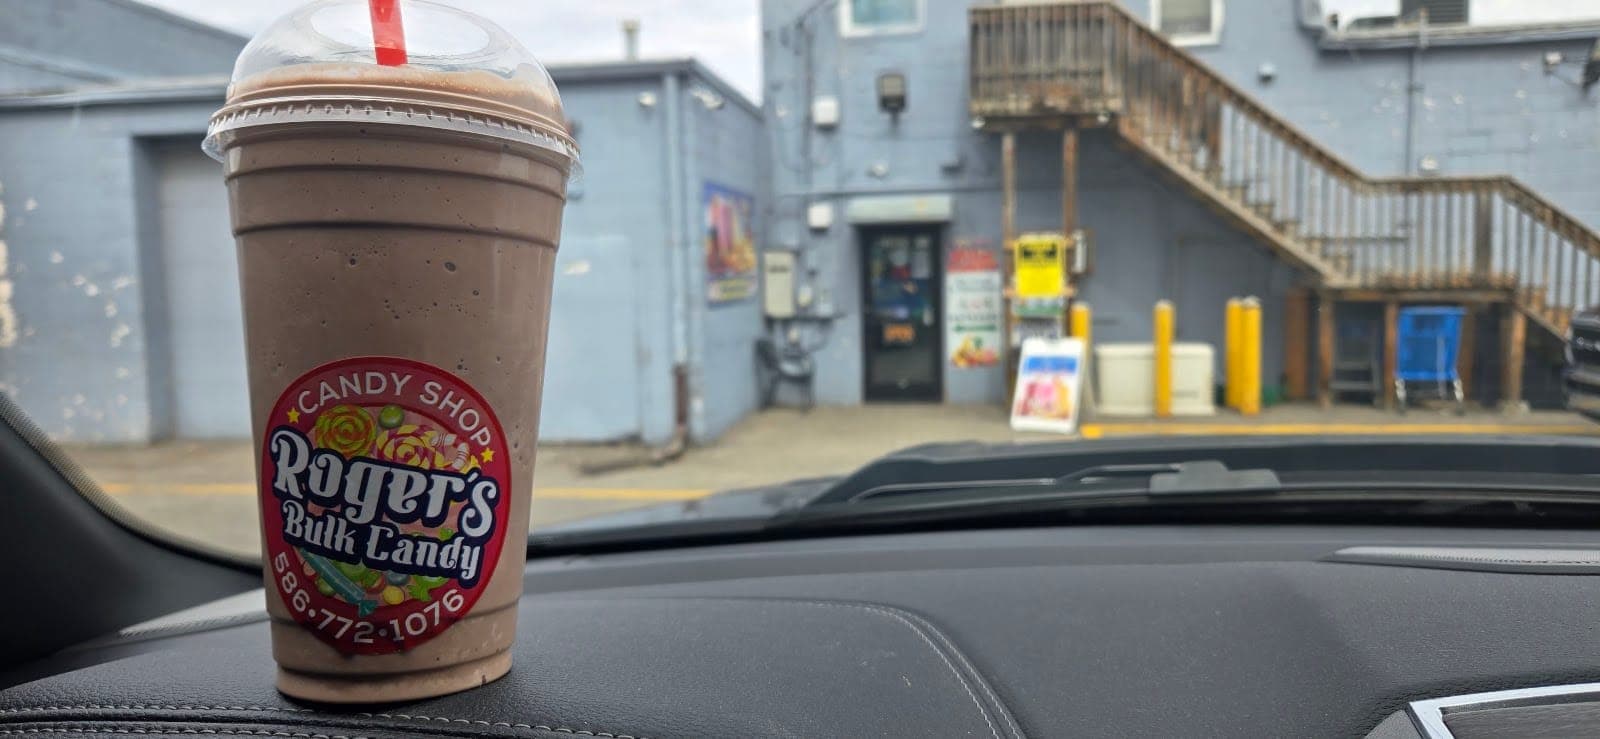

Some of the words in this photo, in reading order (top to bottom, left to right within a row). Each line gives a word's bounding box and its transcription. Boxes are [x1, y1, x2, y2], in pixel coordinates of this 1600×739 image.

[299, 372, 412, 414] CANDY
[420, 382, 492, 447] SHOP
[271, 430, 497, 537] Roger's
[283, 500, 357, 555] Bulk
[366, 525, 481, 580] Candy
